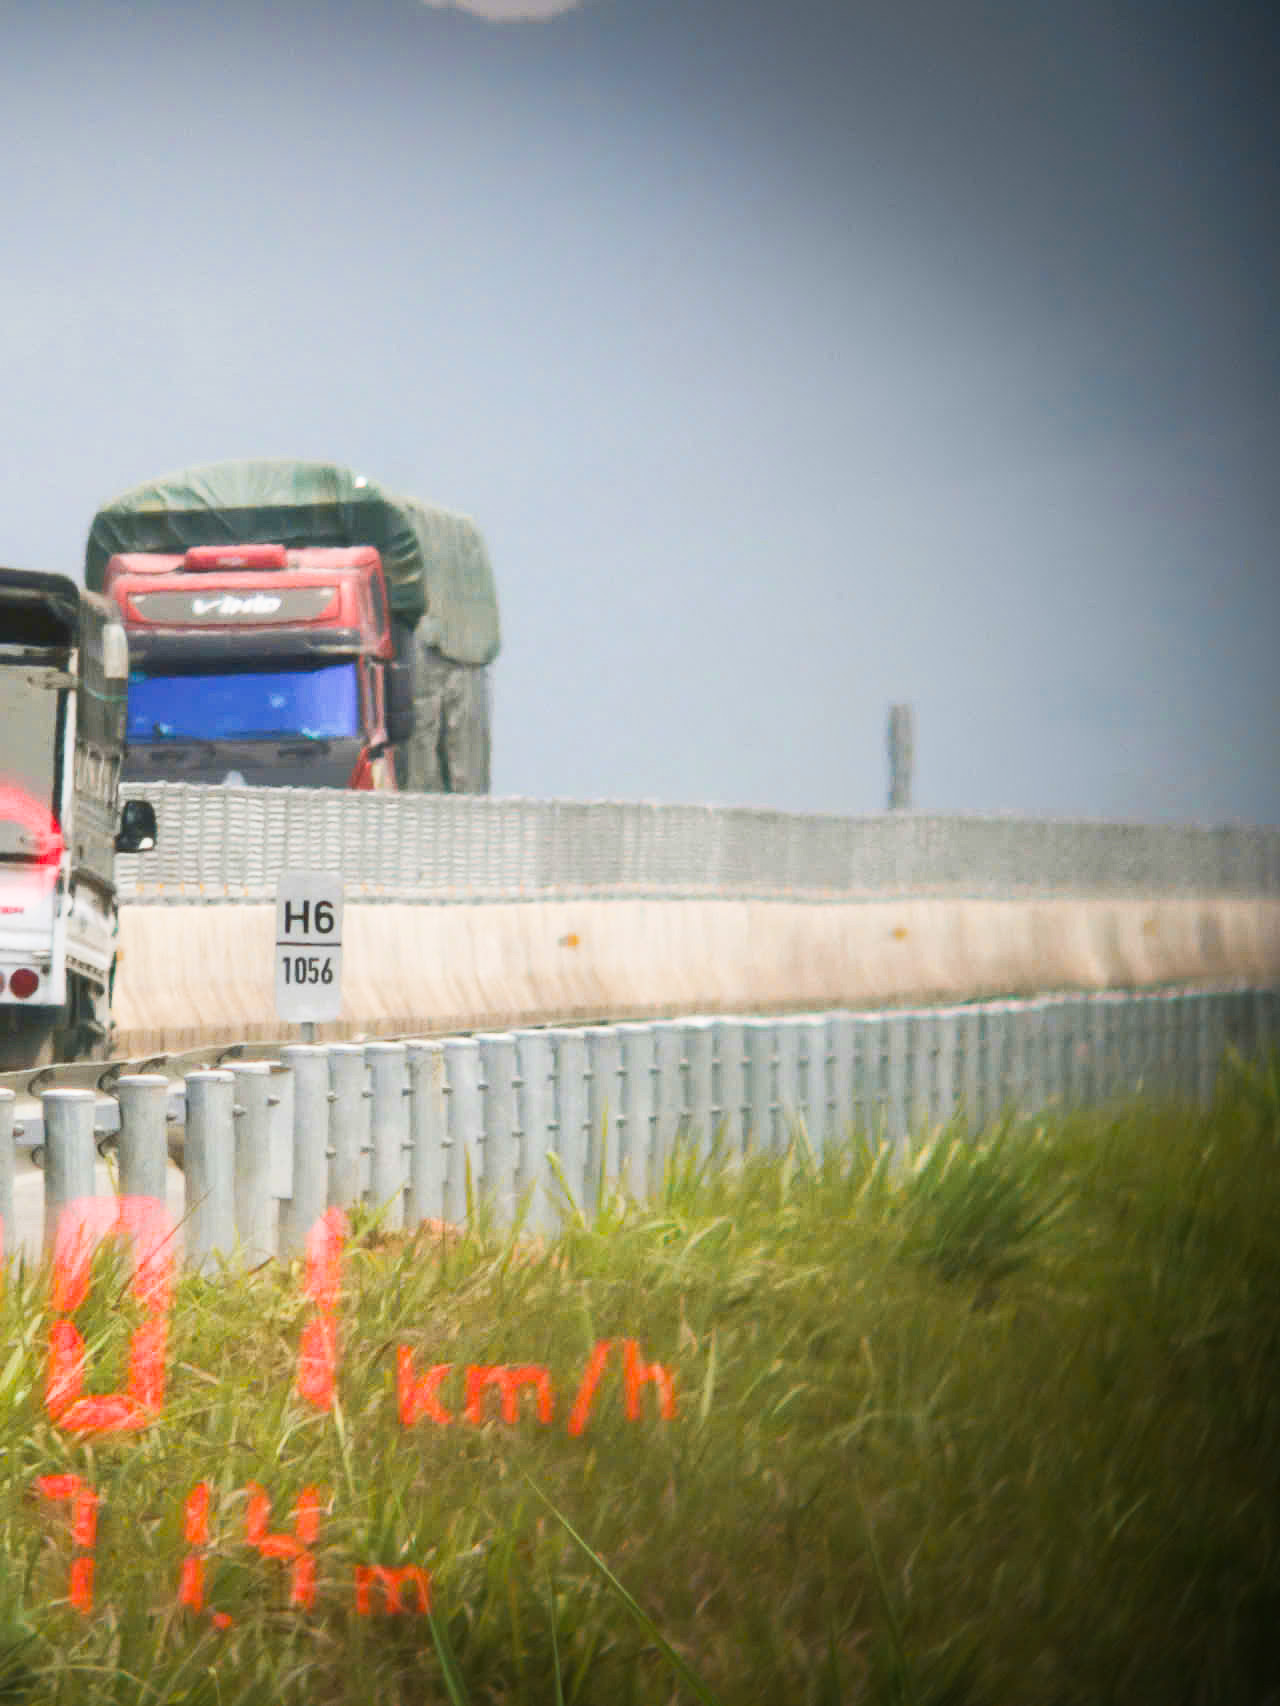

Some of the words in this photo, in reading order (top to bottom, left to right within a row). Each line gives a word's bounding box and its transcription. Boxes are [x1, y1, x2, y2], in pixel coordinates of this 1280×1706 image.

[284, 900, 334, 934] H6
[282, 956, 333, 985] 1056
[396, 1337, 679, 1437] km/h
[354, 1562, 434, 1616] m
